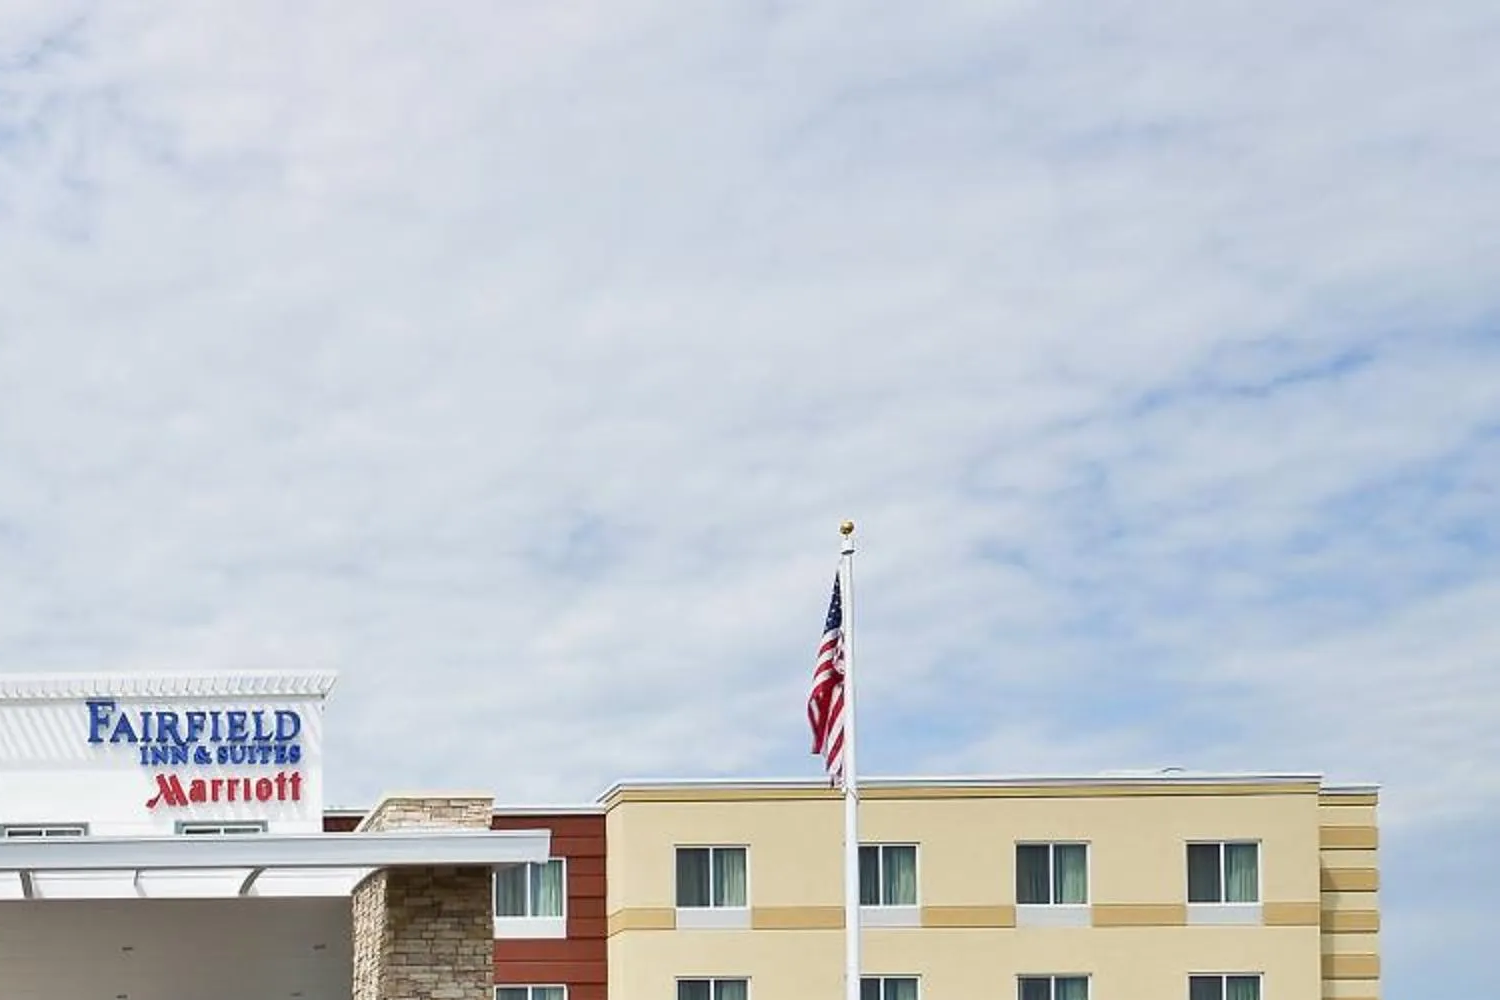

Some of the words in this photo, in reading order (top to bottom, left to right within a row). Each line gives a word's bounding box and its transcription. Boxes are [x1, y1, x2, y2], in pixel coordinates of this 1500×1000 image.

[86, 699, 301, 745] FAIRFIELD
[140, 746, 188, 765] INN
[194, 746, 212, 765] &
[217, 746, 301, 765] SUITES
[146, 772, 302, 807] Marriott
